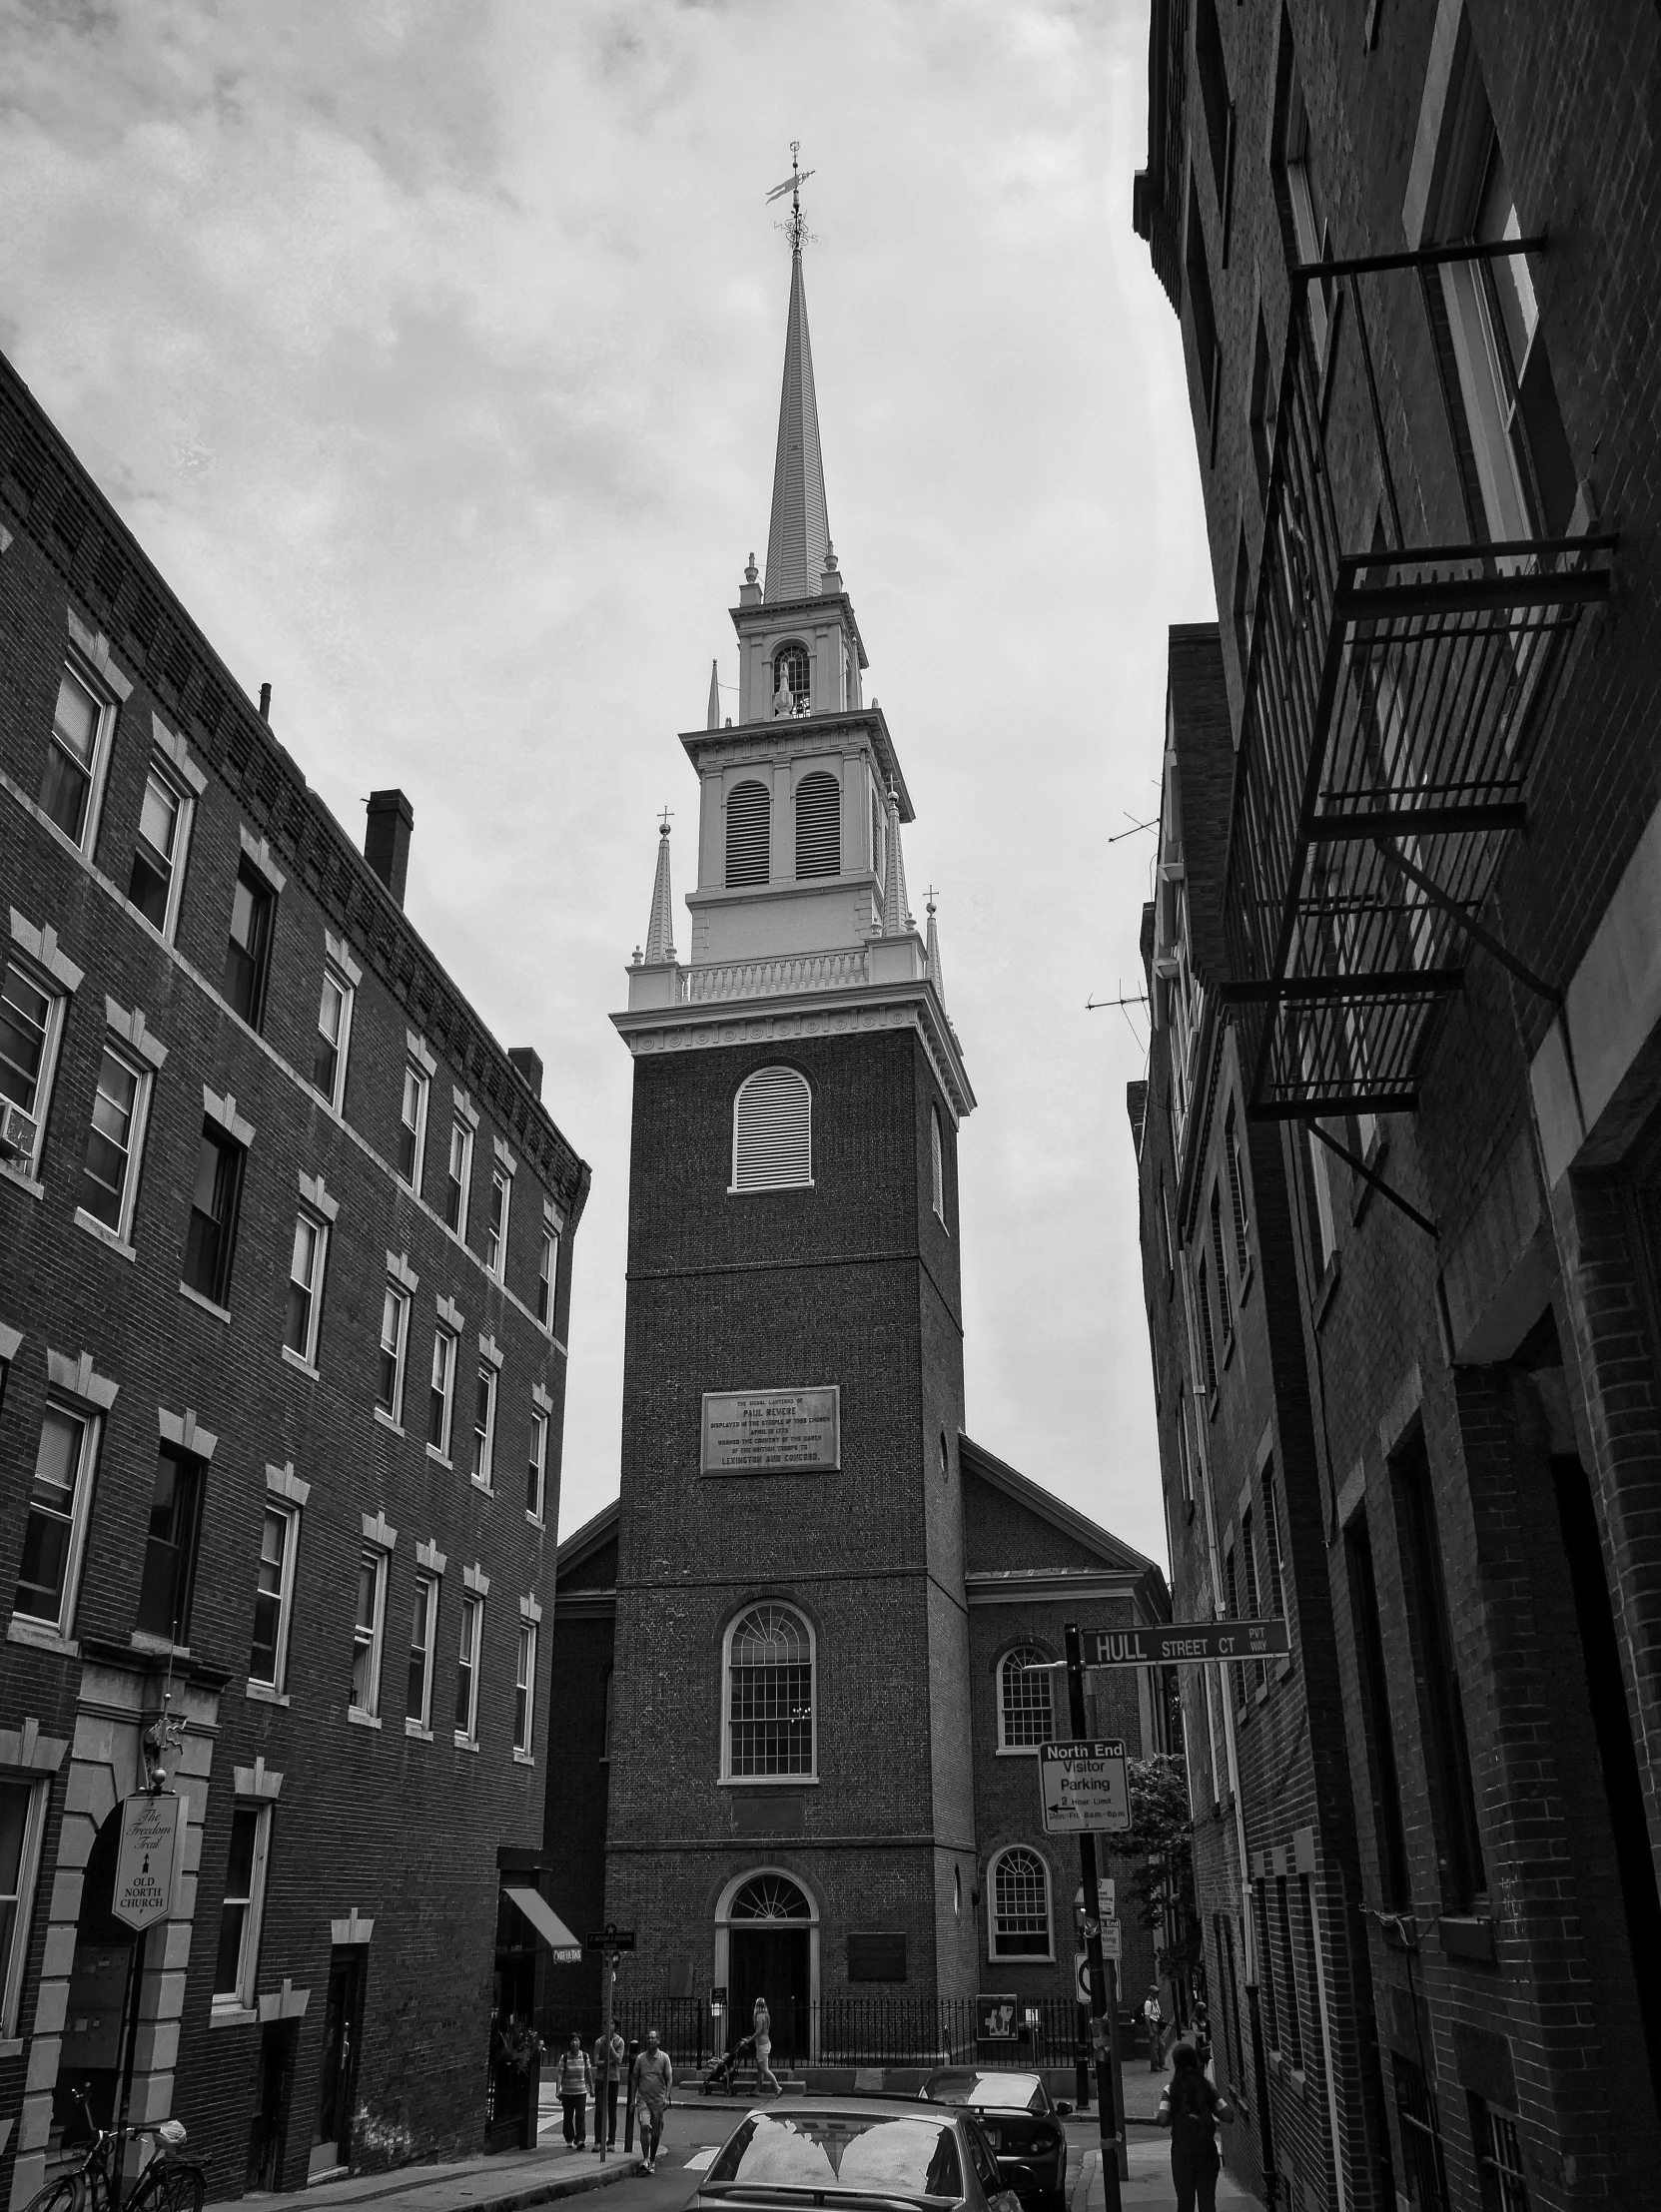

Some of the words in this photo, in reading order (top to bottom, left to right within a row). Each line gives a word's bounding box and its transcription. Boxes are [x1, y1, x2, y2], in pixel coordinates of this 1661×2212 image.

[766, 1407, 797, 1416] REVERE
[1248, 1627, 1265, 1639] PVT
[1097, 1634, 1148, 1662] HULL
[1162, 1638, 1209, 1657] STREET
[1218, 1637, 1235, 1654] CT
[1249, 1640, 1267, 1652] WAY
[1047, 1744, 1089, 1760] North
[1094, 1743, 1124, 1757] End
[1063, 1760, 1105, 1773] Visitor
[1060, 1778, 1110, 1792] Parking
[1061, 1797, 1068, 1806] 2
[138, 1809, 162, 1823] The
[126, 1822, 172, 1836] Freedom
[133, 1836, 163, 1850] Trail
[133, 1877, 155, 1886] OLD
[124, 1888, 161, 1897] NORTH
[120, 1898, 163, 1908] CHURCH
